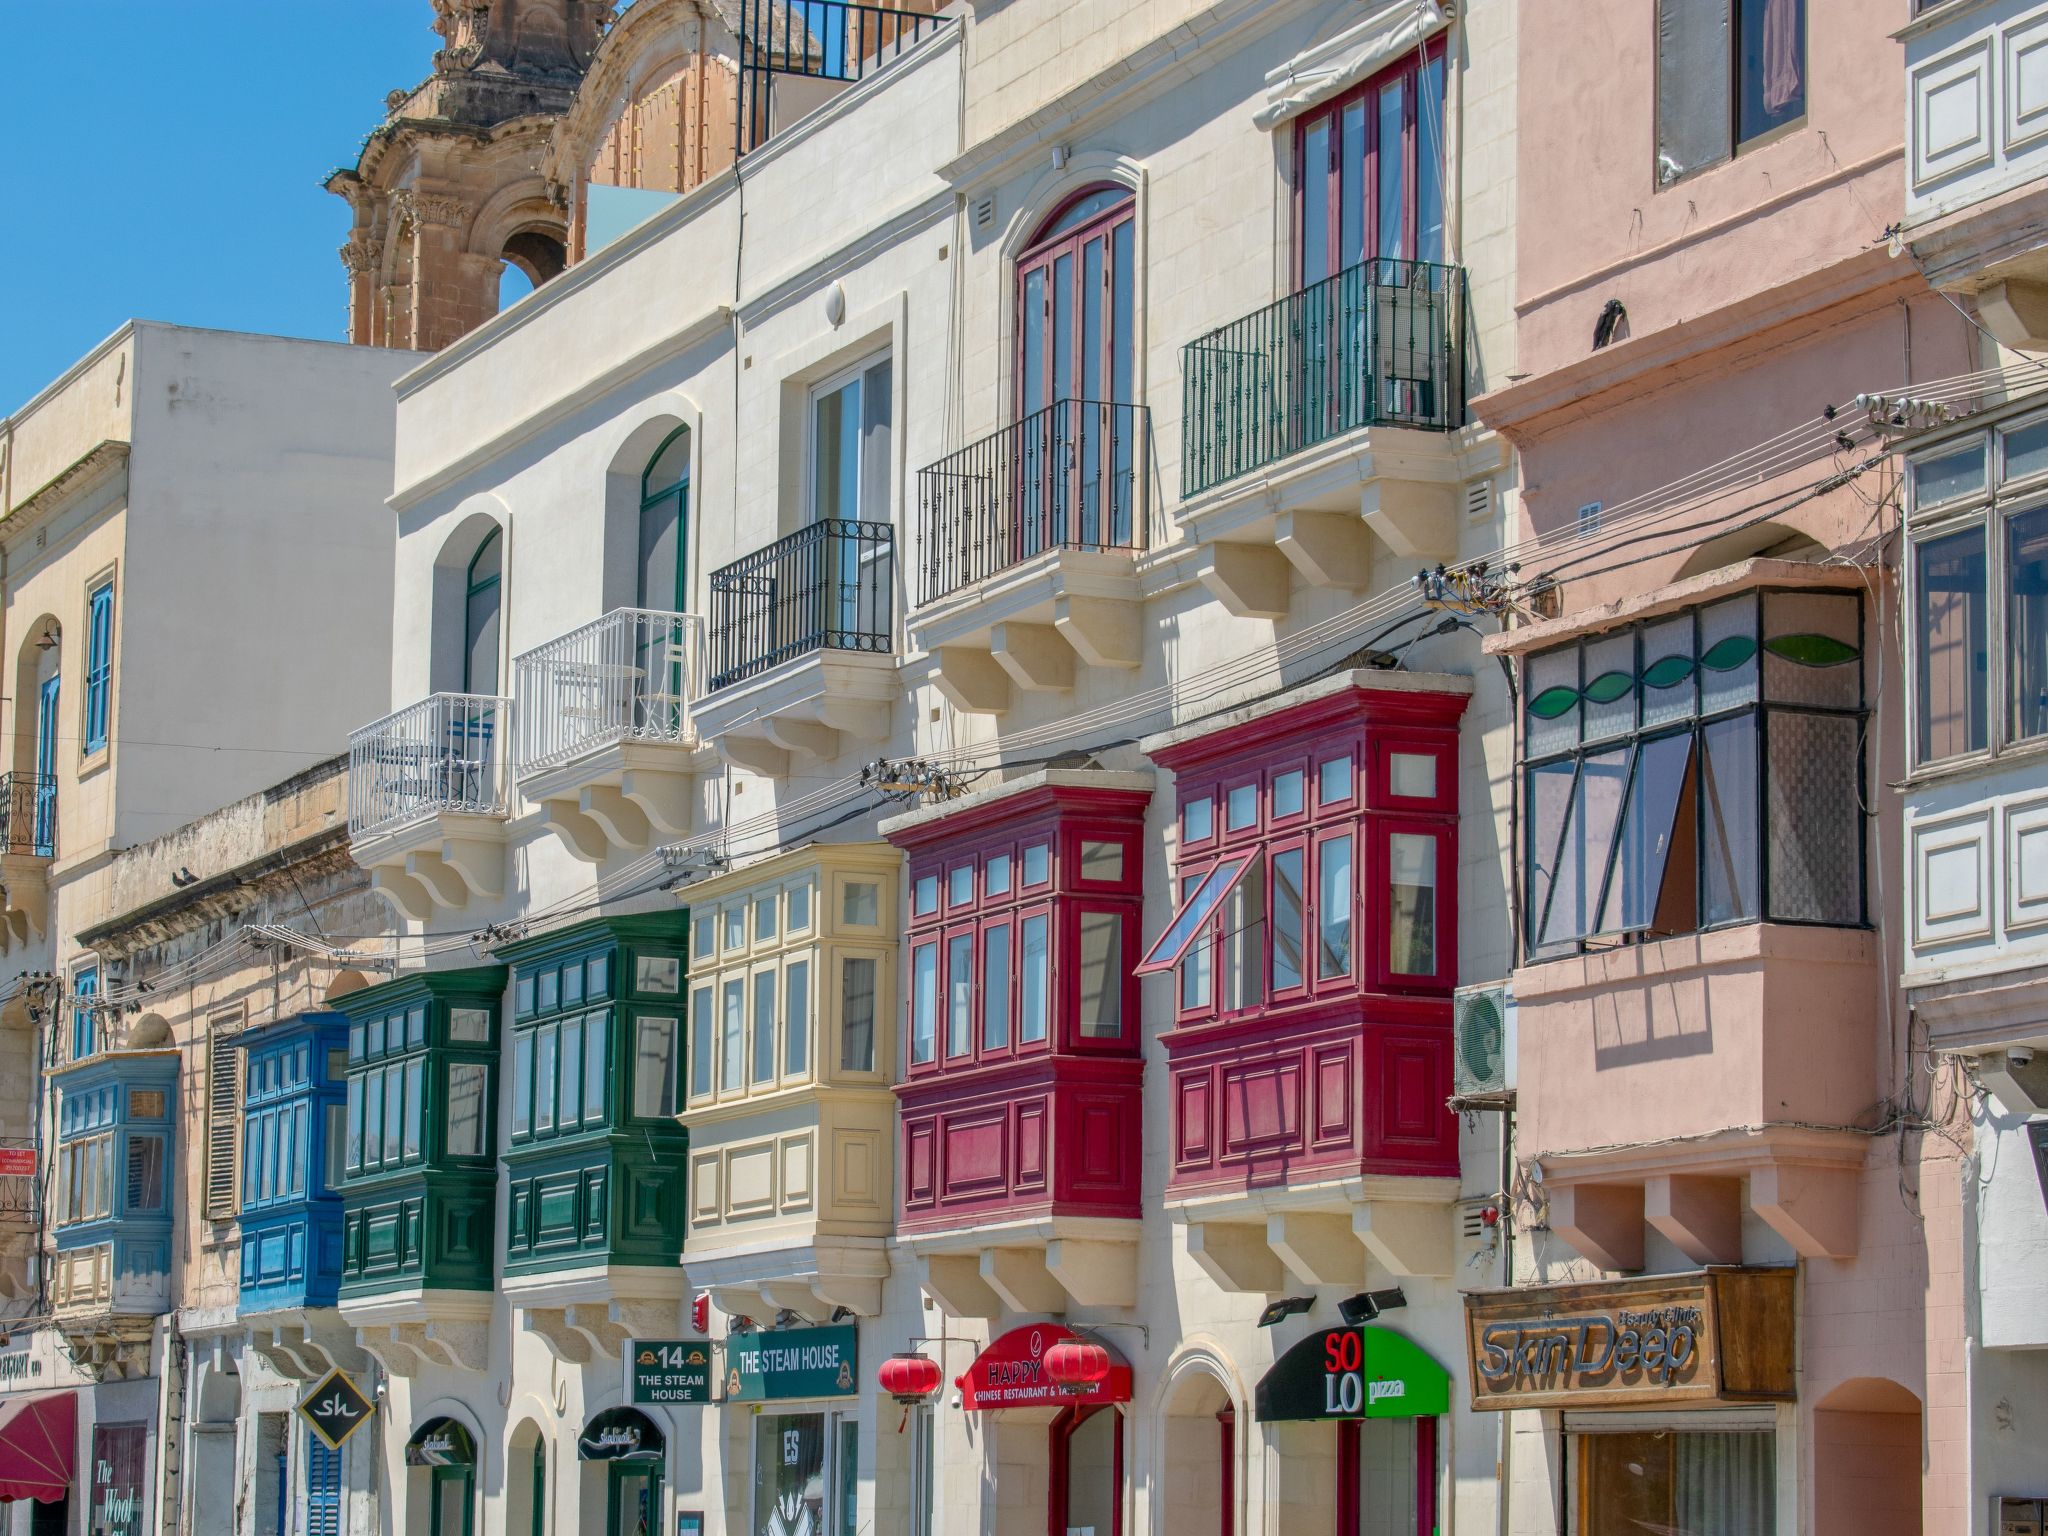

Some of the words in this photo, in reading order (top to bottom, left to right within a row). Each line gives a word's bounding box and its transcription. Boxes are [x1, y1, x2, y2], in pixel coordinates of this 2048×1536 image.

[657, 1346, 685, 1369] 14
[740, 1350, 760, 1374] THE
[762, 1347, 799, 1373] STEAM
[801, 1344, 839, 1370] HOUSE
[1325, 1331, 1362, 1373] SO
[1573, 1316, 1693, 1382] Deep
[639, 1375, 662, 1386] THE
[664, 1375, 704, 1386] STEAM
[988, 1360, 1041, 1386] HAPPY
[651, 1389, 692, 1400] HOUSE
[974, 1389, 1001, 1402] CHINESE
[1003, 1386, 1048, 1400] RESTAURANT
[1049, 1385, 1056, 1396] &
[1325, 1372, 1362, 1413] LO
[1368, 1376, 1405, 1405] pizza
[97, 1459, 113, 1484] The
[104, 1487, 134, 1523] Wool
